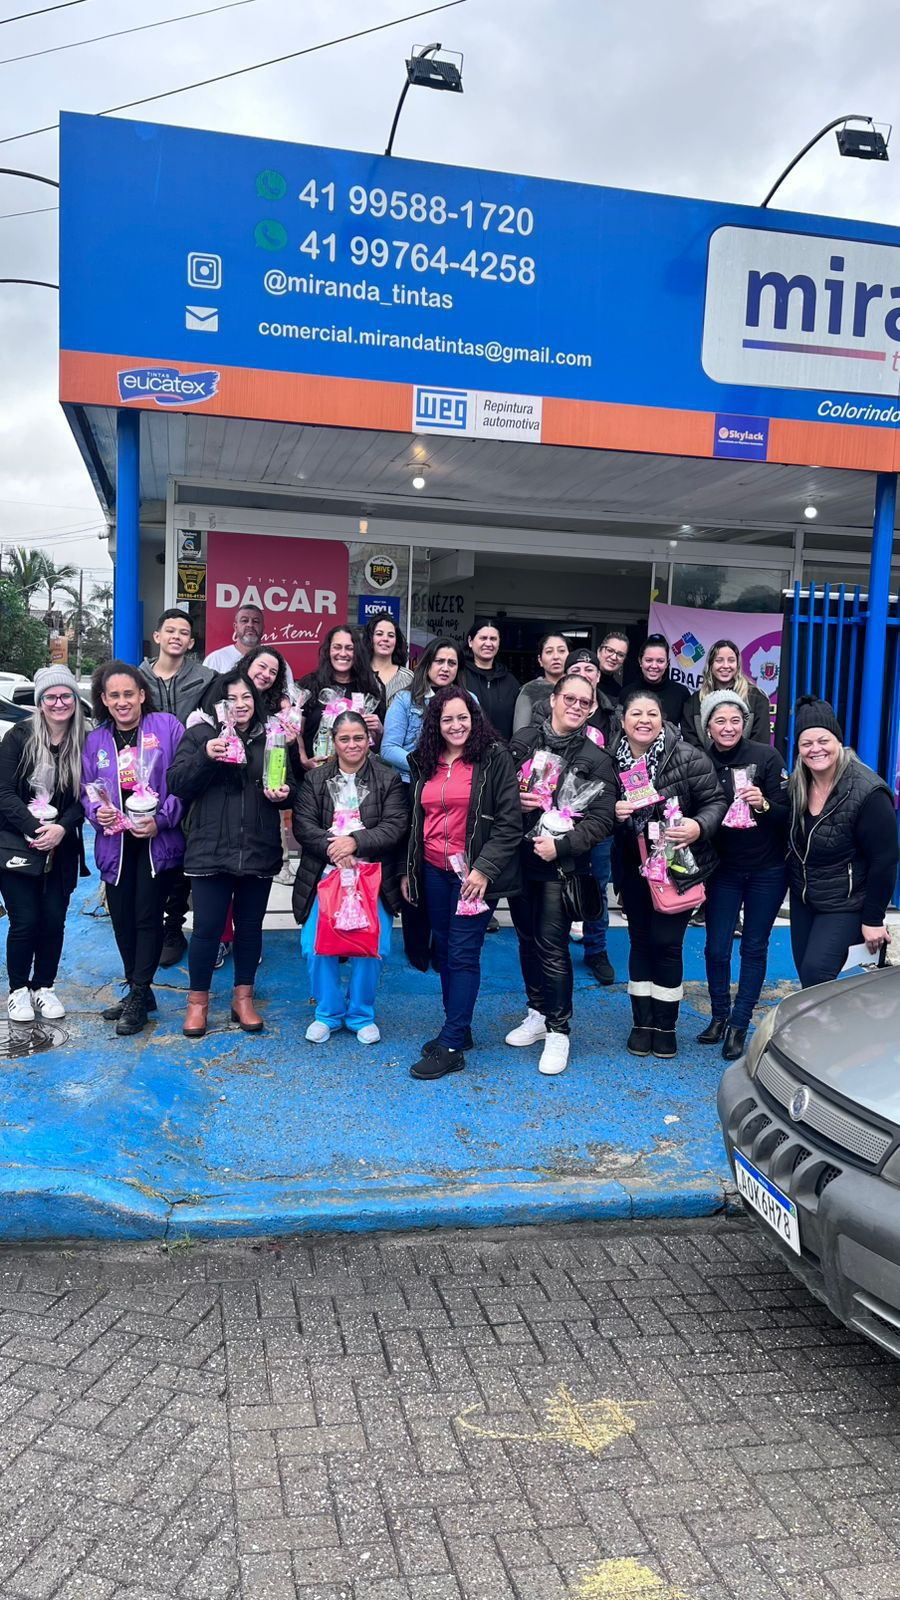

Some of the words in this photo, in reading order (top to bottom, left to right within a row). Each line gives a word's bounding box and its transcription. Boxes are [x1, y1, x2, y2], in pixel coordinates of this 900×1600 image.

[299, 179, 335, 211] 41
[349, 185, 534, 236] 99588-1720
[300, 230, 336, 262] 41
[350, 235, 535, 285] 99764-4258
[263, 269, 453, 308] @miranda_tintas
[258, 322, 592, 367] comercial.mirandatintas@gmail.com
[123, 375, 206, 395] eucatex
[483, 399, 533, 414] Repintura
[483, 416, 540, 430] automotiva
[729, 429, 763, 440] Skylack
[247, 576, 311, 586] TINTAS
[215, 583, 337, 615] DACAR
[280, 620, 322, 639] tem!
